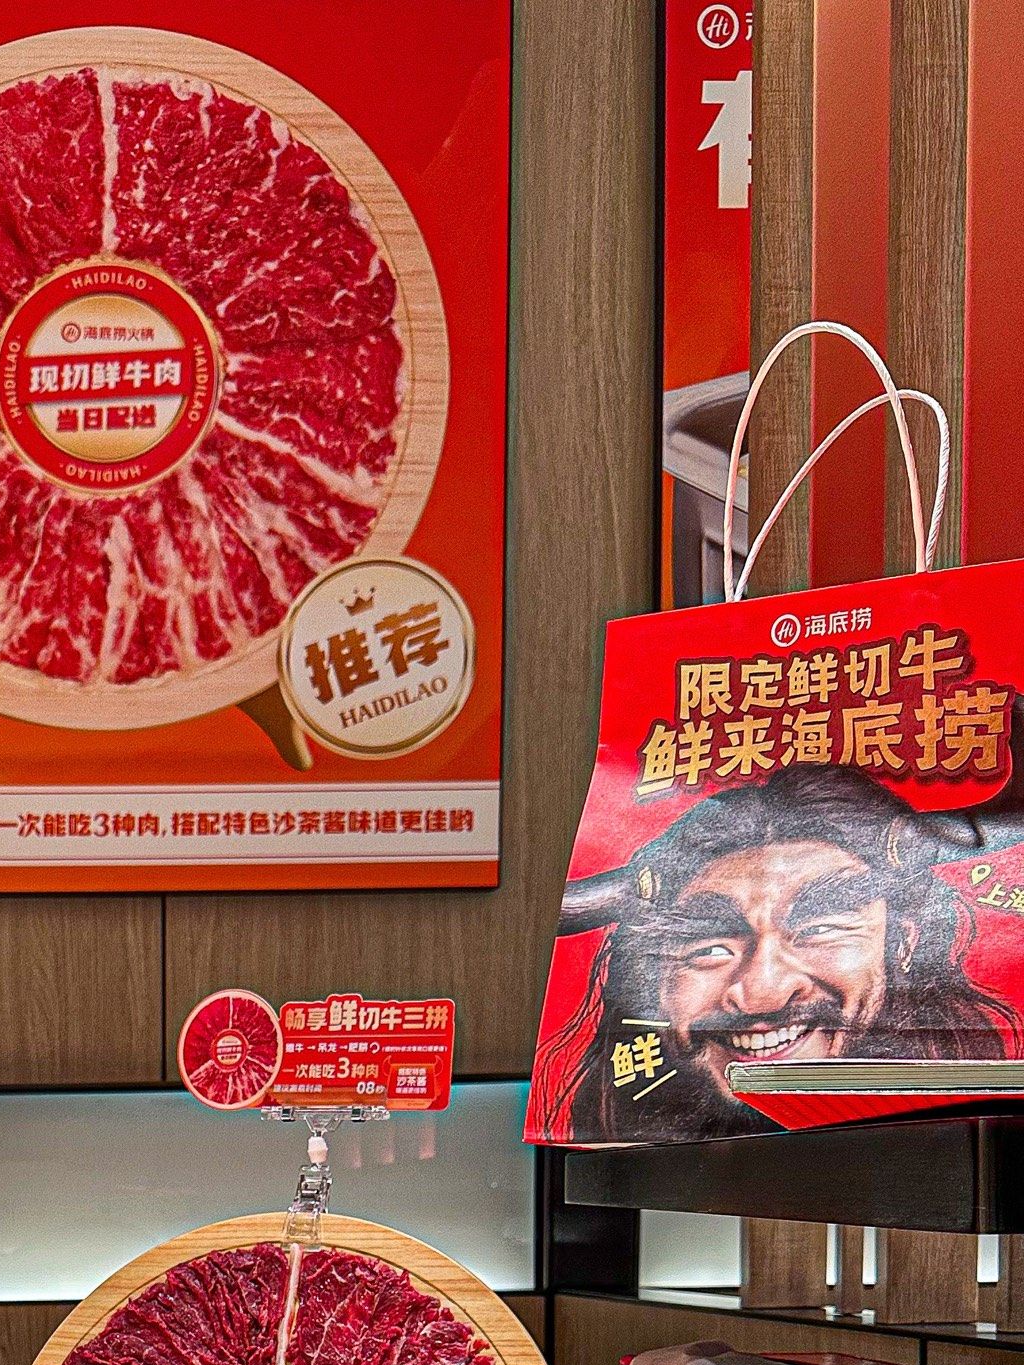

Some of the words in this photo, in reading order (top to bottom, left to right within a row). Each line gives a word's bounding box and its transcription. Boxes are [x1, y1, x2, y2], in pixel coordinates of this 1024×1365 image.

[71, 271, 147, 291] HAIDILAO
[83, 326, 154, 341] 海底捞火锅
[3, 341, 22, 419] HAIDILAO
[29, 359, 182, 393] 现切鲜牛肉
[190, 343, 208, 424] HAIDILAO
[55, 405, 157, 432] 当日配送
[65, 464, 142, 483] HAIDILAO
[804, 607, 872, 637] 海底捞
[305, 604, 449, 704] 推荐
[679, 630, 965, 720] 限定鲜切牛
[339, 676, 448, 729] HAIDILAO
[637, 687, 1008, 797] 鲜来海底捞
[285, 1000, 448, 1032] 畅享鲜切牛三拼
[282, 1057, 379, 1079] 一次能吃3种肉
[611, 1032, 664, 1087] 鲜
